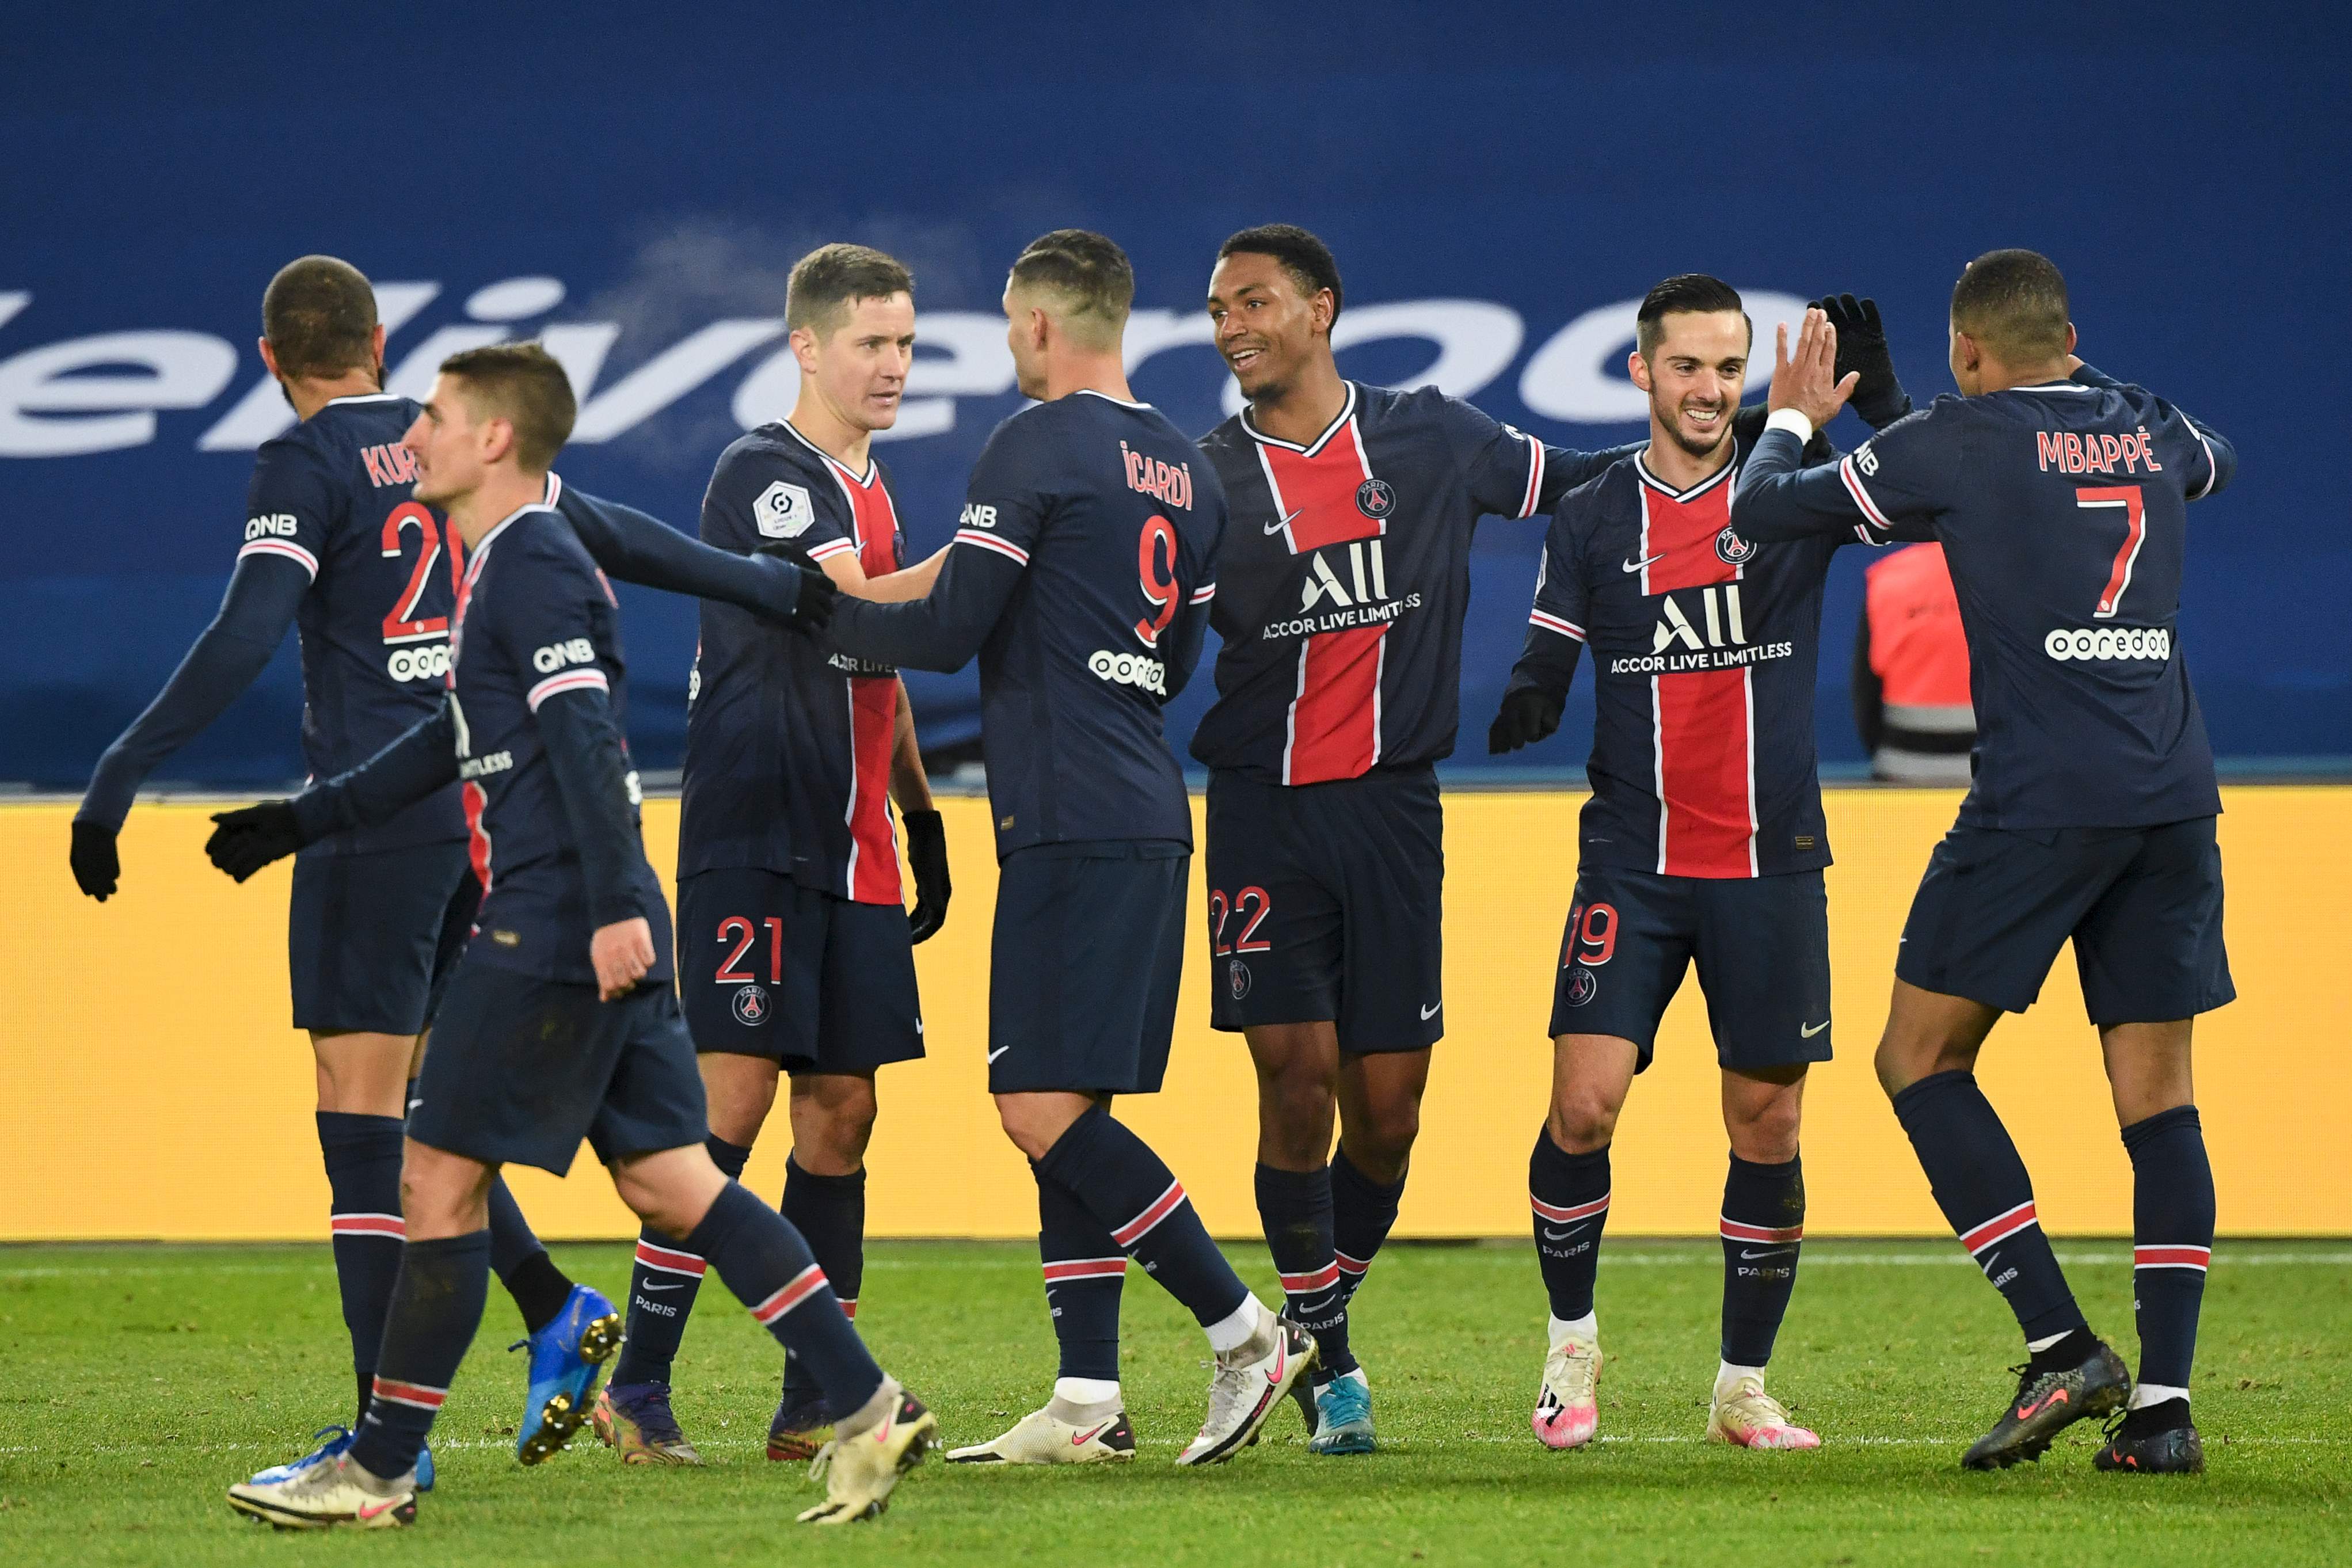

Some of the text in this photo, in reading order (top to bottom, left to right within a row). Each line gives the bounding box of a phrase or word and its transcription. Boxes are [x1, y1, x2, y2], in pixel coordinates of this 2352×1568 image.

[0, 276, 1813, 458] eliveroo
[360, 441, 421, 488] KUR
[245, 513, 297, 541] QNB
[2076, 485, 2146, 618] 7
[1134, 515, 1179, 649] 9
[1262, 618, 1317, 640] ACCOR
[1320, 611, 1357, 631] LIVE
[533, 637, 595, 673] QNB
[1611, 641, 1792, 674] ACCOR LIVE LIMITLESS
[2045, 628, 2170, 661] ooredoo
[1210, 885, 1271, 957] 22
[1563, 902, 1620, 969] 19
[715, 916, 782, 985] 21
[1543, 1241, 1590, 1258] PARIS
[1993, 1268, 2018, 1288] ARIS
[635, 1295, 678, 1317] PARIS
[1300, 1312, 1344, 1330] PARIS
